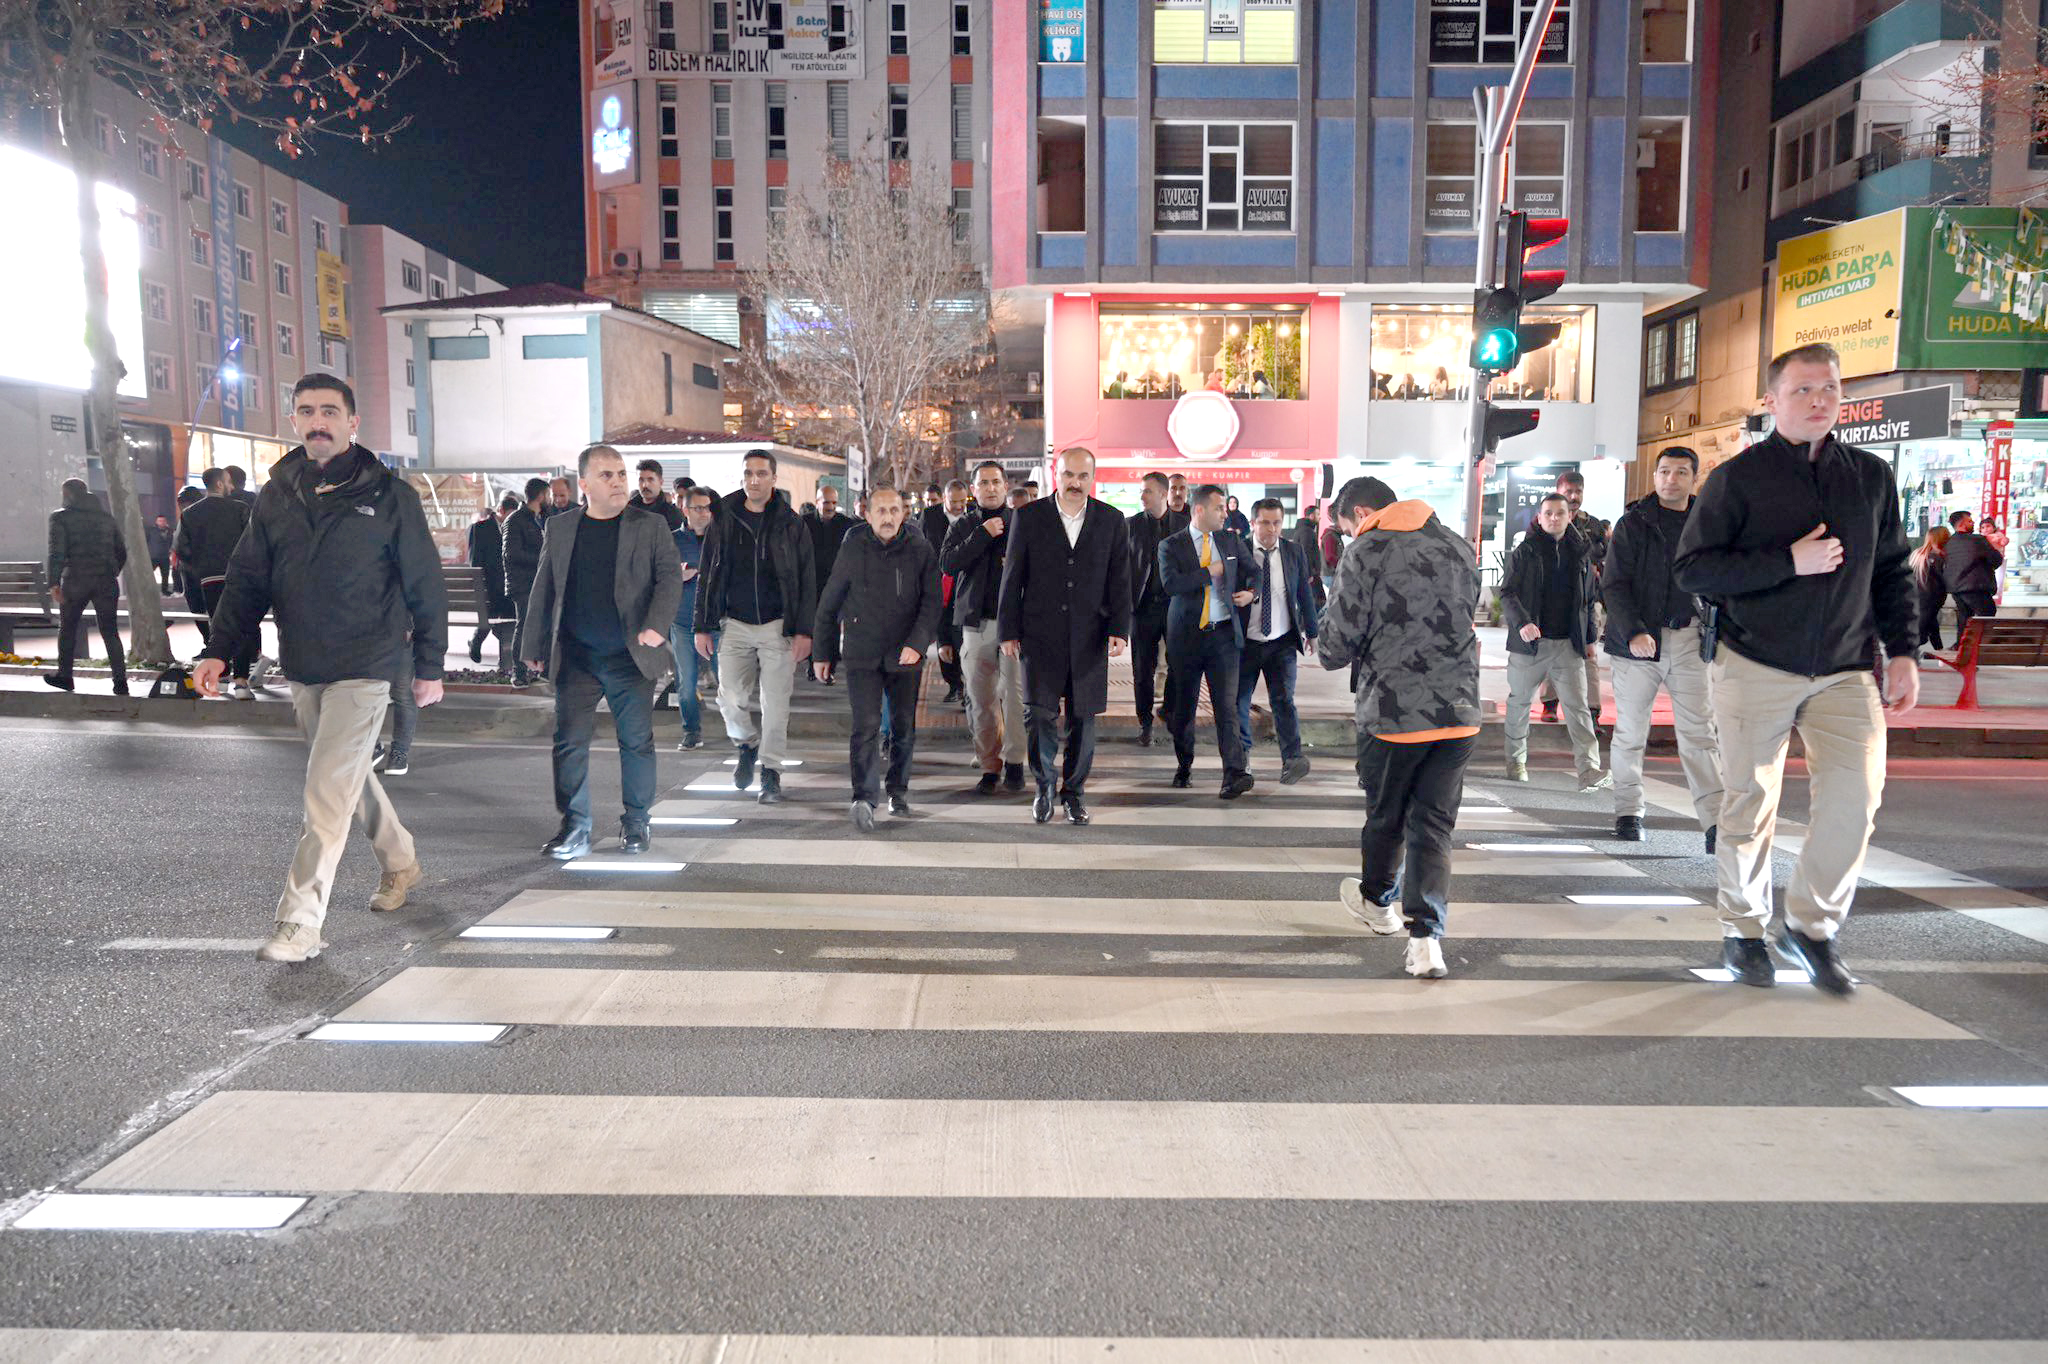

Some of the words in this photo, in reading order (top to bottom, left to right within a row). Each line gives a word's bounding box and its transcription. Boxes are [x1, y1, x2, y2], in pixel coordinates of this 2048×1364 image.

[1066, 8, 1083, 20] DİŞ
[649, 50, 700, 72] BİLSEM
[705, 50, 769, 73] HAZIRLIK
[792, 63, 805, 71] FEN
[806, 61, 847, 71] ATÖLYELERİ
[1158, 187, 1199, 206] AVUKAT
[1247, 188, 1288, 207] AVUKAT
[1436, 193, 1465, 202] AVUKAT
[1525, 193, 1554, 202] AVUKAT
[1454, 209, 1471, 217] KAYA
[1543, 208, 1560, 216] KAYA
[1808, 244, 1865, 264] MEMLEKETİN
[1781, 266, 1831, 292] HÜDA
[1801, 284, 1845, 306] İHTİYACI
[1847, 277, 1871, 293] VAR
[1795, 326, 1839, 344] Pêdivîya
[1842, 318, 1872, 335] welat
[1948, 315, 2012, 333] HÜDA
[1860, 335, 1889, 349] heye
[1837, 400, 1884, 425] ENGE
[1841, 418, 1910, 443] KIRTASİYE
[1131, 449, 1157, 459] Waffle
